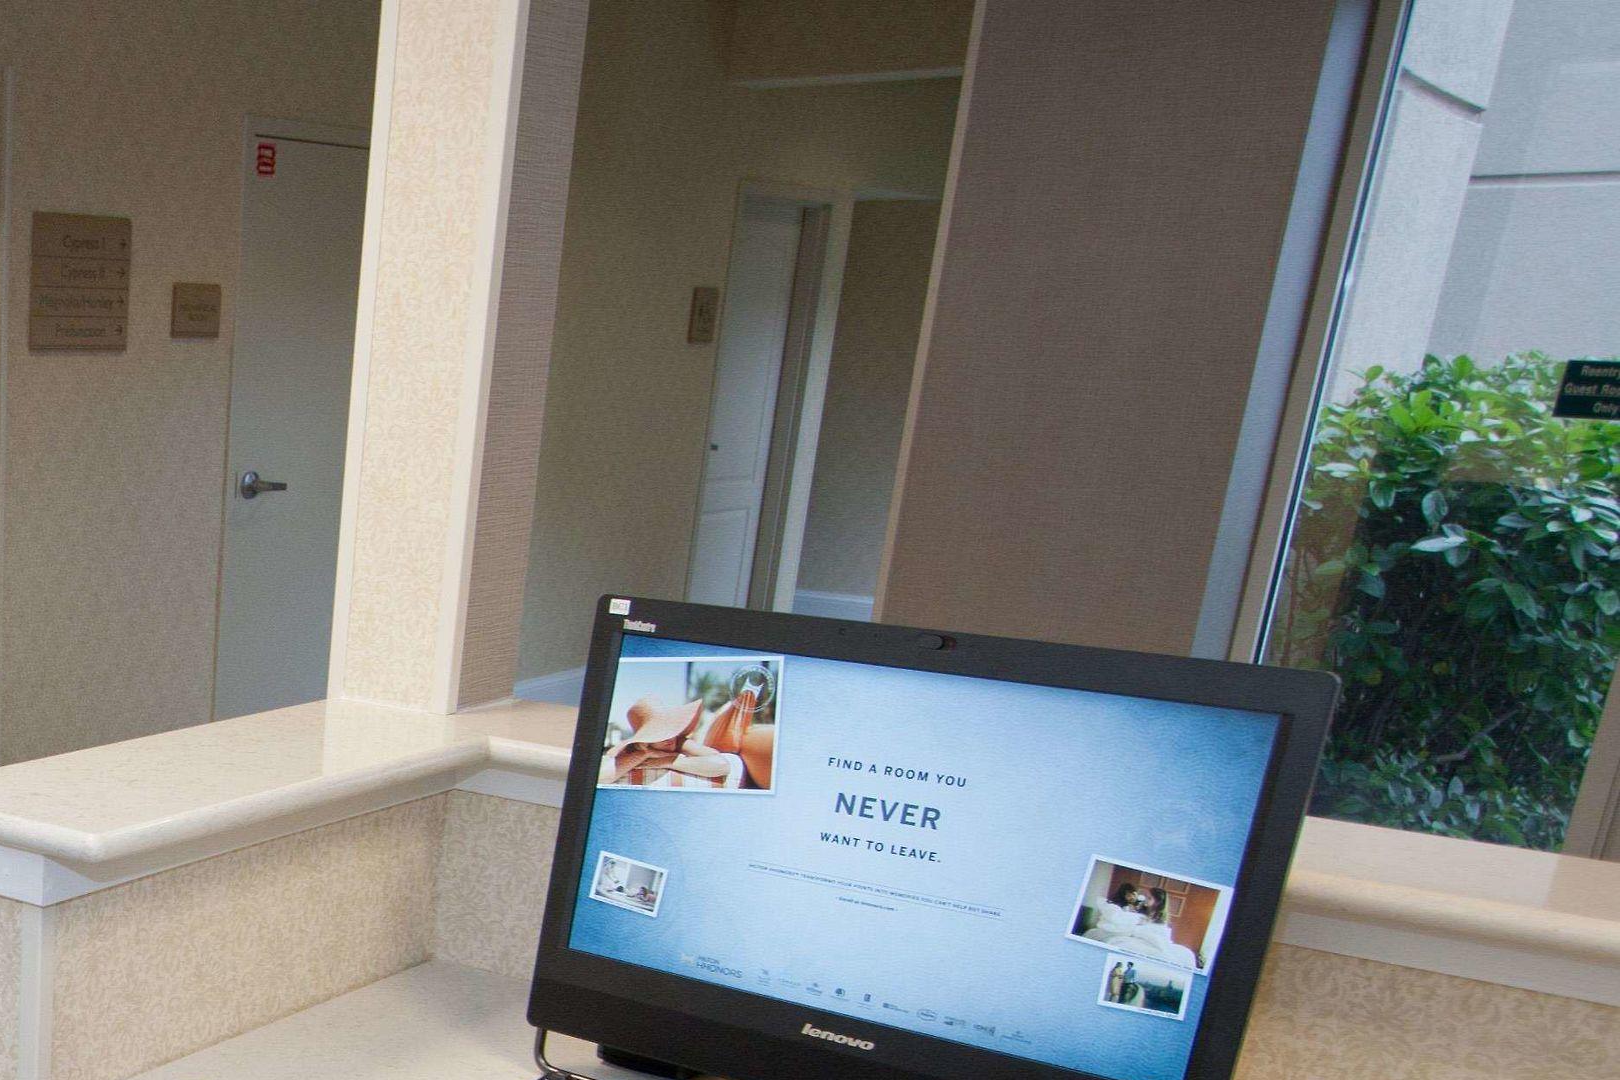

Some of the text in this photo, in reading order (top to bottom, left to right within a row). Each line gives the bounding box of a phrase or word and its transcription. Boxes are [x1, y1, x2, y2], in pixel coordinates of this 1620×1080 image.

[1564, 383, 1598, 396] Guest
[828, 757, 967, 788] FIND A ROOM YOU
[834, 792, 941, 830] NEVER
[820, 832, 941, 863] WANT TO LEAVE.
[801, 1023, 875, 1051] lenovo
